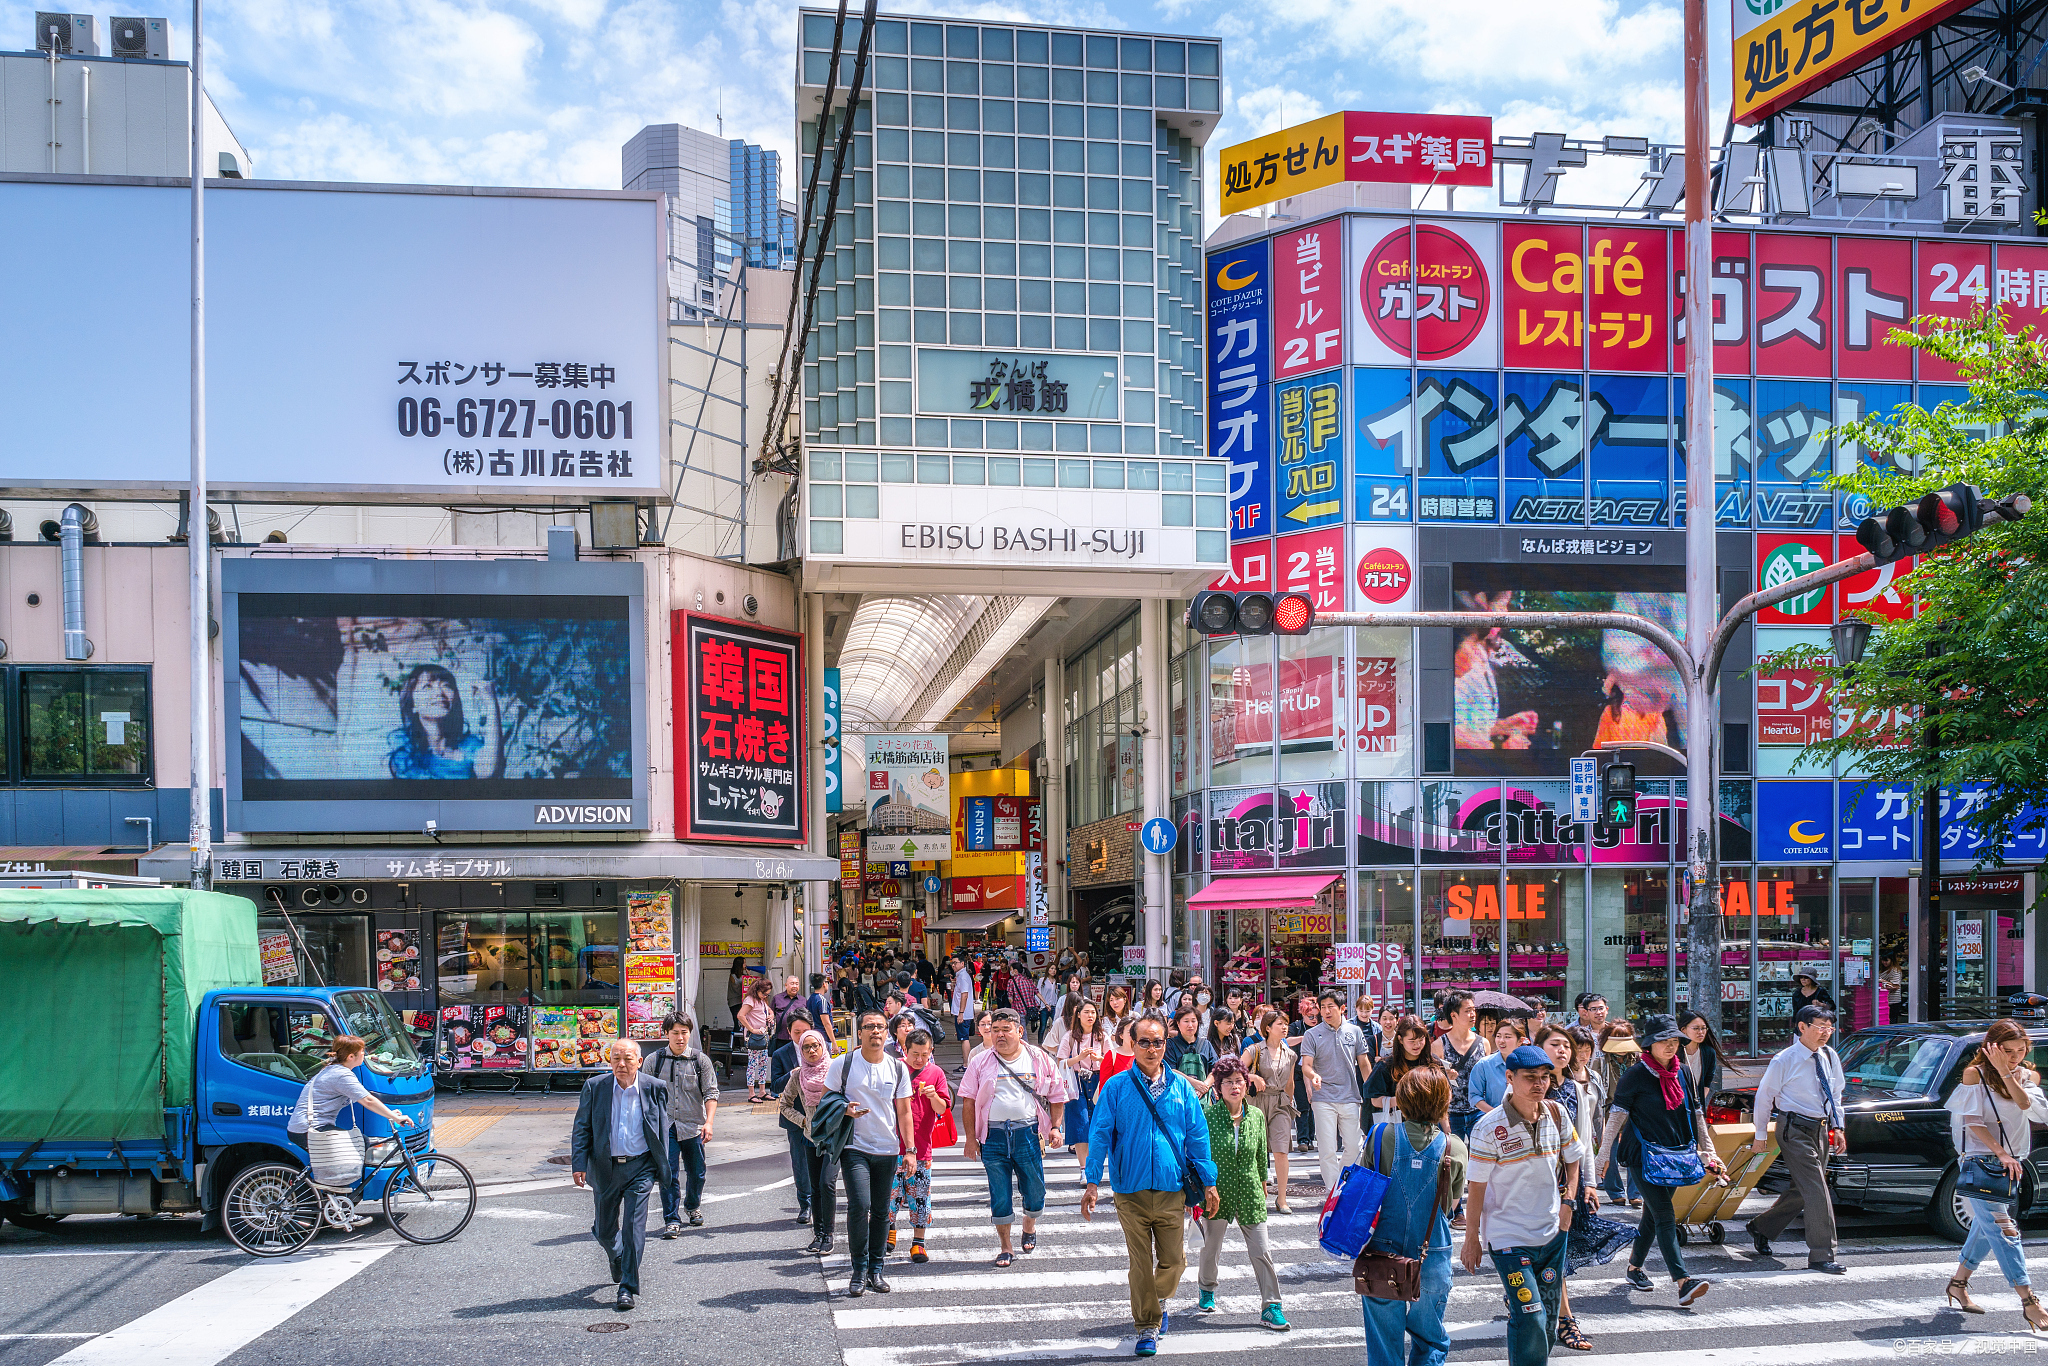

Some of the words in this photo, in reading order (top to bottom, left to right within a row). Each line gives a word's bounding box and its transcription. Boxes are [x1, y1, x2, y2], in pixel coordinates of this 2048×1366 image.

[1352, 132, 1485, 167] スギ薬局
[1225, 136, 1338, 198] 処方せん
[1296, 233, 1323, 329] 当ビル
[1420, 264, 1472, 280] レストラン
[1512, 239, 1644, 295] Café
[1930, 263, 1989, 303] 24
[1211, 297, 1233, 308] COTE
[1211, 298, 1263, 317] コート・ダジュール
[1379, 283, 1477, 321] ガスト
[1676, 257, 1907, 350] ガスト
[1519, 309, 1652, 348] レストラン
[1283, 329, 1340, 369] 2F
[397, 361, 615, 389] スポンサー募集中
[990, 357, 1049, 380] なんば
[970, 378, 1068, 413] 戎橋筋
[1217, 318, 1259, 501] カラオケ
[398, 397, 633, 440] 06-6727-0601
[1281, 390, 1305, 464] 当ビル
[1311, 386, 1338, 452] 3F
[443, 449, 633, 478] (株)古川広告社
[1288, 465, 1335, 497] 入口
[1230, 502, 1261, 531] 1F
[1373, 487, 1408, 516] 24
[1421, 498, 1494, 518] 時間営業
[1660, 491, 1832, 524] PANET
[901, 524, 984, 550] EBISU
[993, 526, 1144, 559] BASHI-SUJI
[1521, 539, 1652, 555] なんば戎橋ビジョン
[1217, 555, 1266, 588] 入口
[1315, 547, 1337, 609] 当ビル
[1364, 572, 1406, 588] ガスト
[701, 638, 788, 716] 韓国
[701, 711, 790, 763] 石焼き
[700, 762, 792, 785] サムギョプサル専門店
[1573, 762, 1584, 795] 自転車
[1584, 762, 1594, 795] 歩行者
[1580, 797, 1589, 818] 専用
[975, 810, 985, 843] カラオケ
[1842, 825, 2048, 850] コートダジュー
[221, 860, 263, 879] 韓国
[280, 860, 340, 879] 石焼き
[387, 859, 511, 878] サムギョプサル
[756, 859, 774, 879] Bel
[954, 893, 976, 902] PUMA
[1448, 884, 1546, 920] SALE
[1948, 880, 2019, 891] レストラン・ショッピング
[1957, 923, 1981, 935] ¥1980
[1337, 946, 1364, 959] ¥1980
[1337, 966, 1364, 980] ¥2380
[1874, 1112, 1892, 1122] GPS
